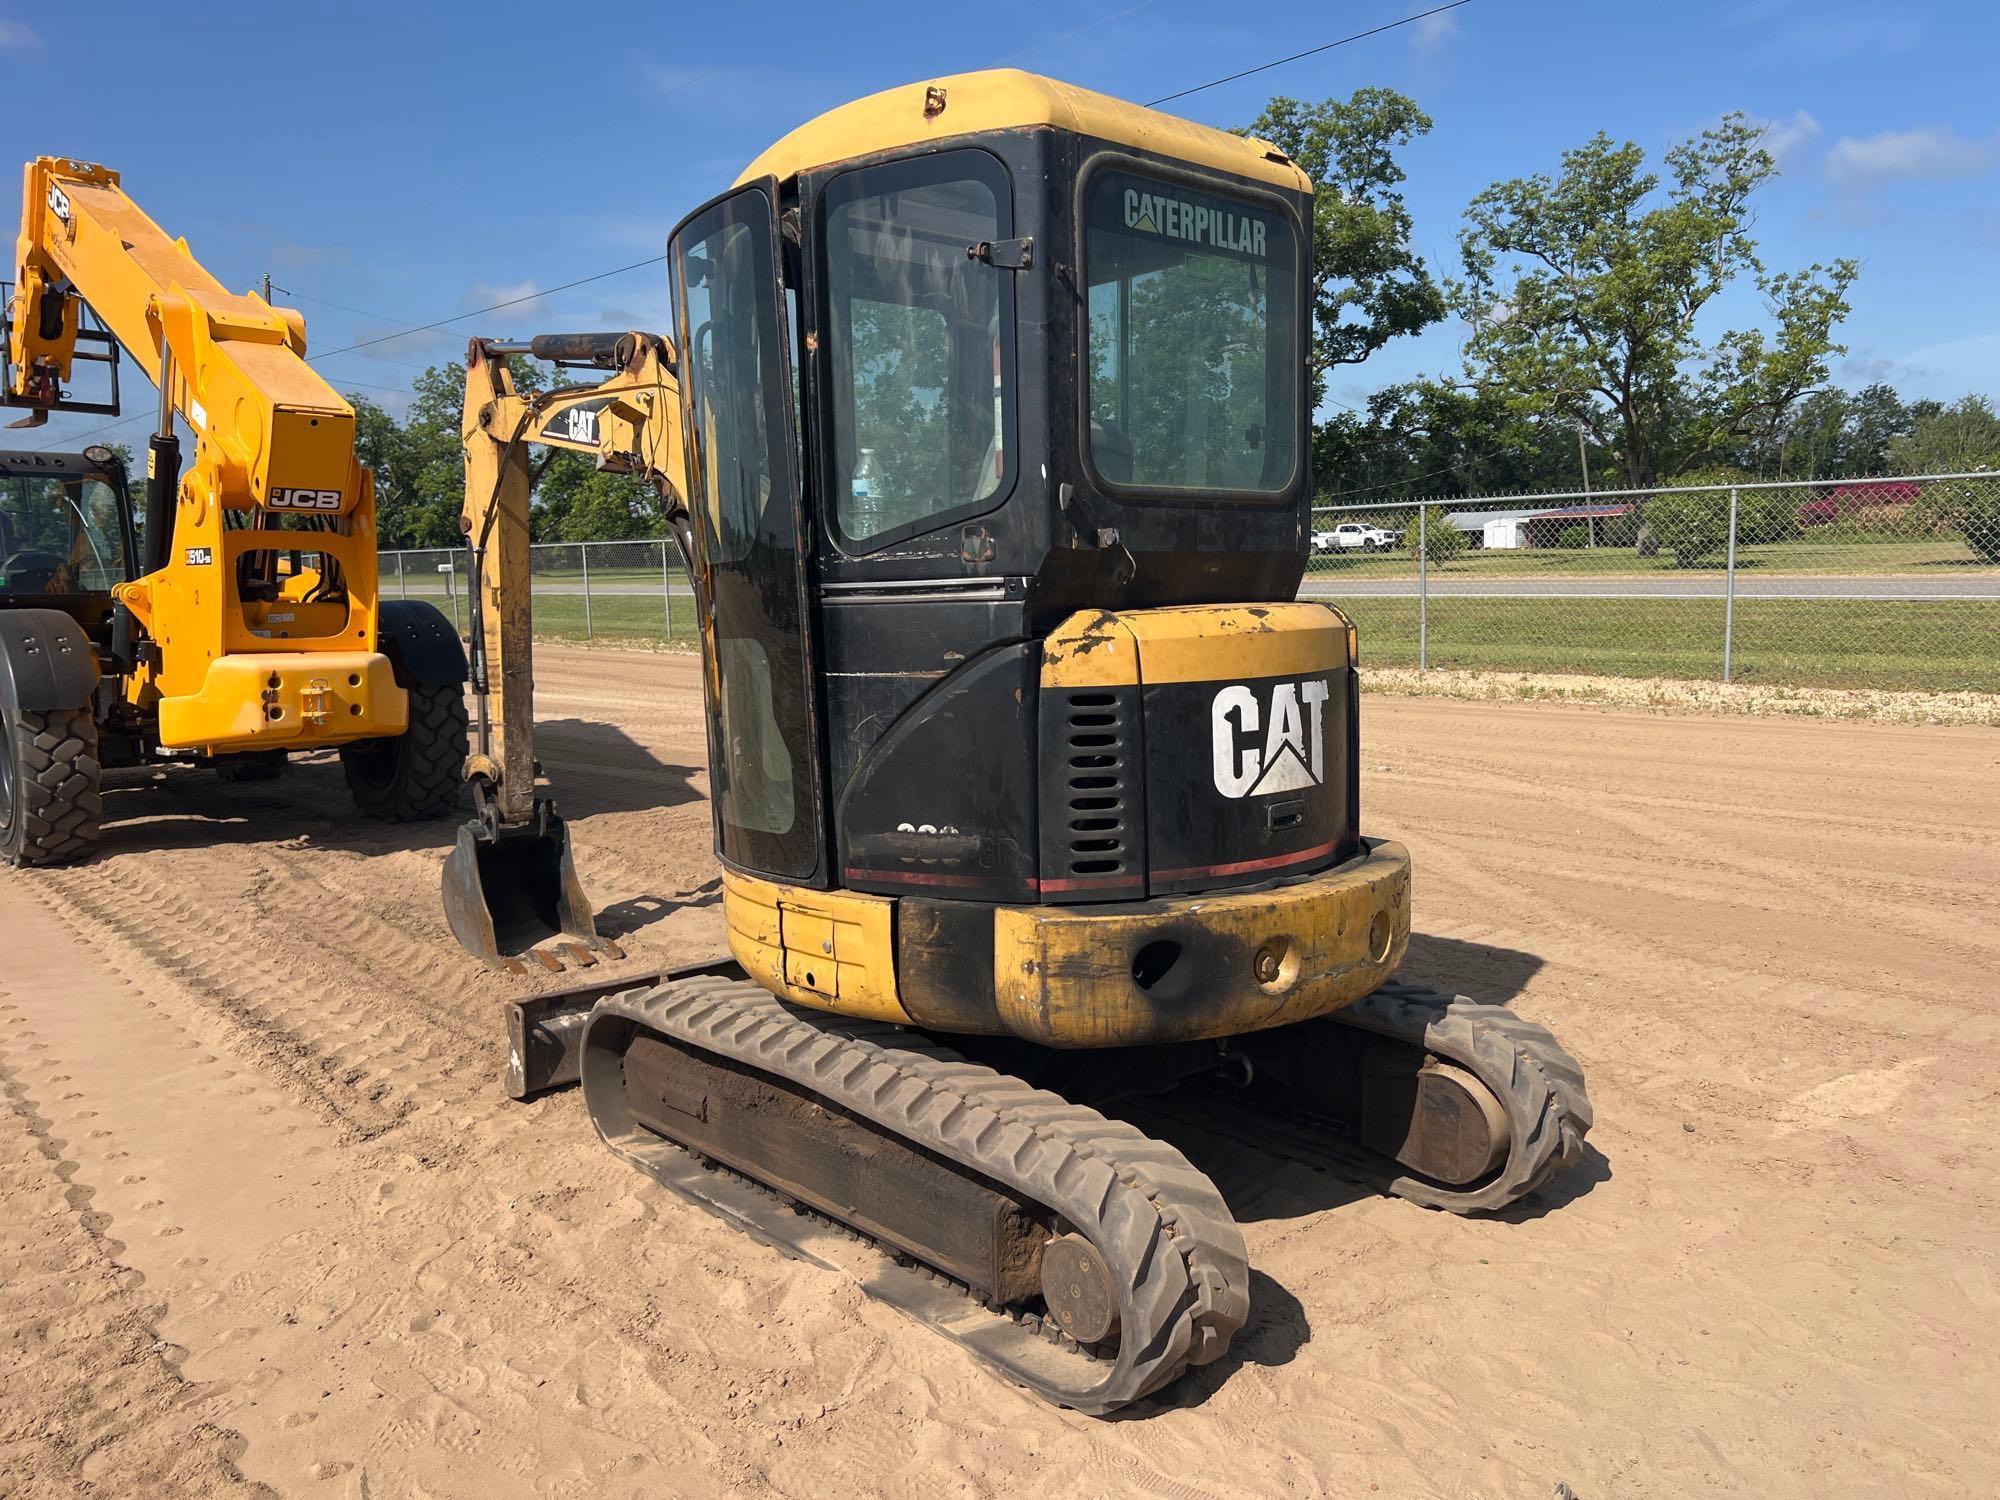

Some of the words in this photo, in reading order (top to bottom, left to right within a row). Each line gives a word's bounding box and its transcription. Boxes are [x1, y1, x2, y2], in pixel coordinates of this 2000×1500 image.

[48, 183, 70, 219] JCB
[1124, 188, 1266, 257] CATERPILLAR
[569, 408, 596, 443] CAT
[271, 489, 340, 509] JCB
[1212, 679, 1329, 798] CAT
